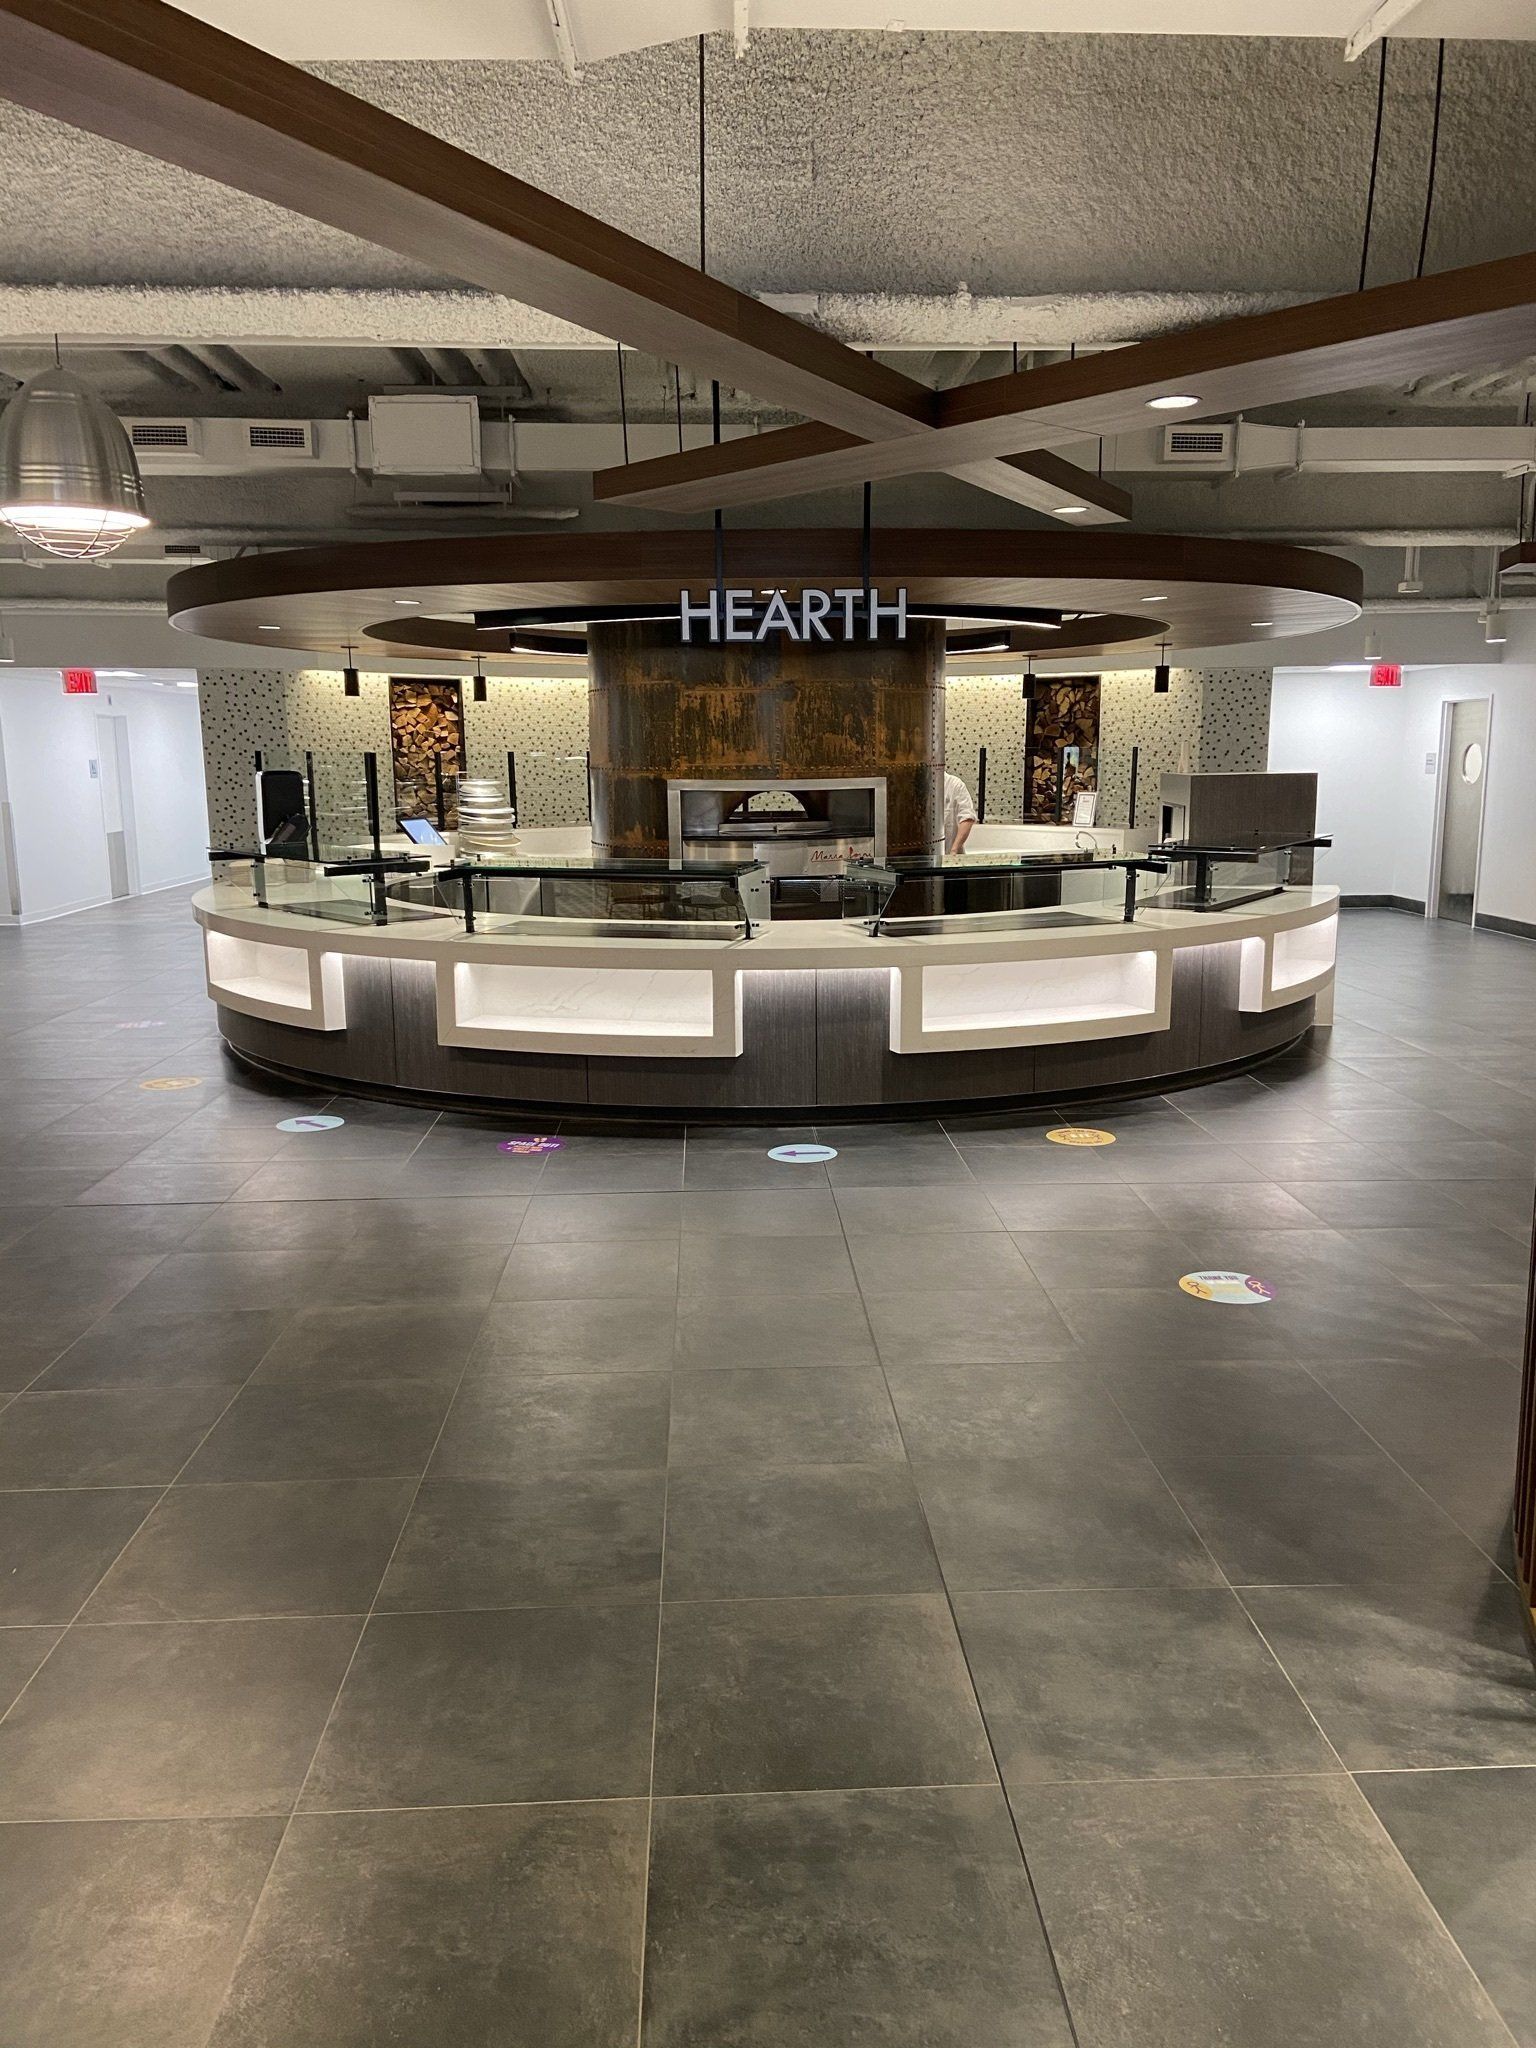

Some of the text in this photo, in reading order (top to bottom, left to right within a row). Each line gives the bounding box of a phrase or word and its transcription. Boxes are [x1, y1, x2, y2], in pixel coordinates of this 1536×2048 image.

[680, 588, 907, 641] HEARTH
[67, 671, 92, 692] EXIT
[1375, 665, 1399, 685] EXIT
